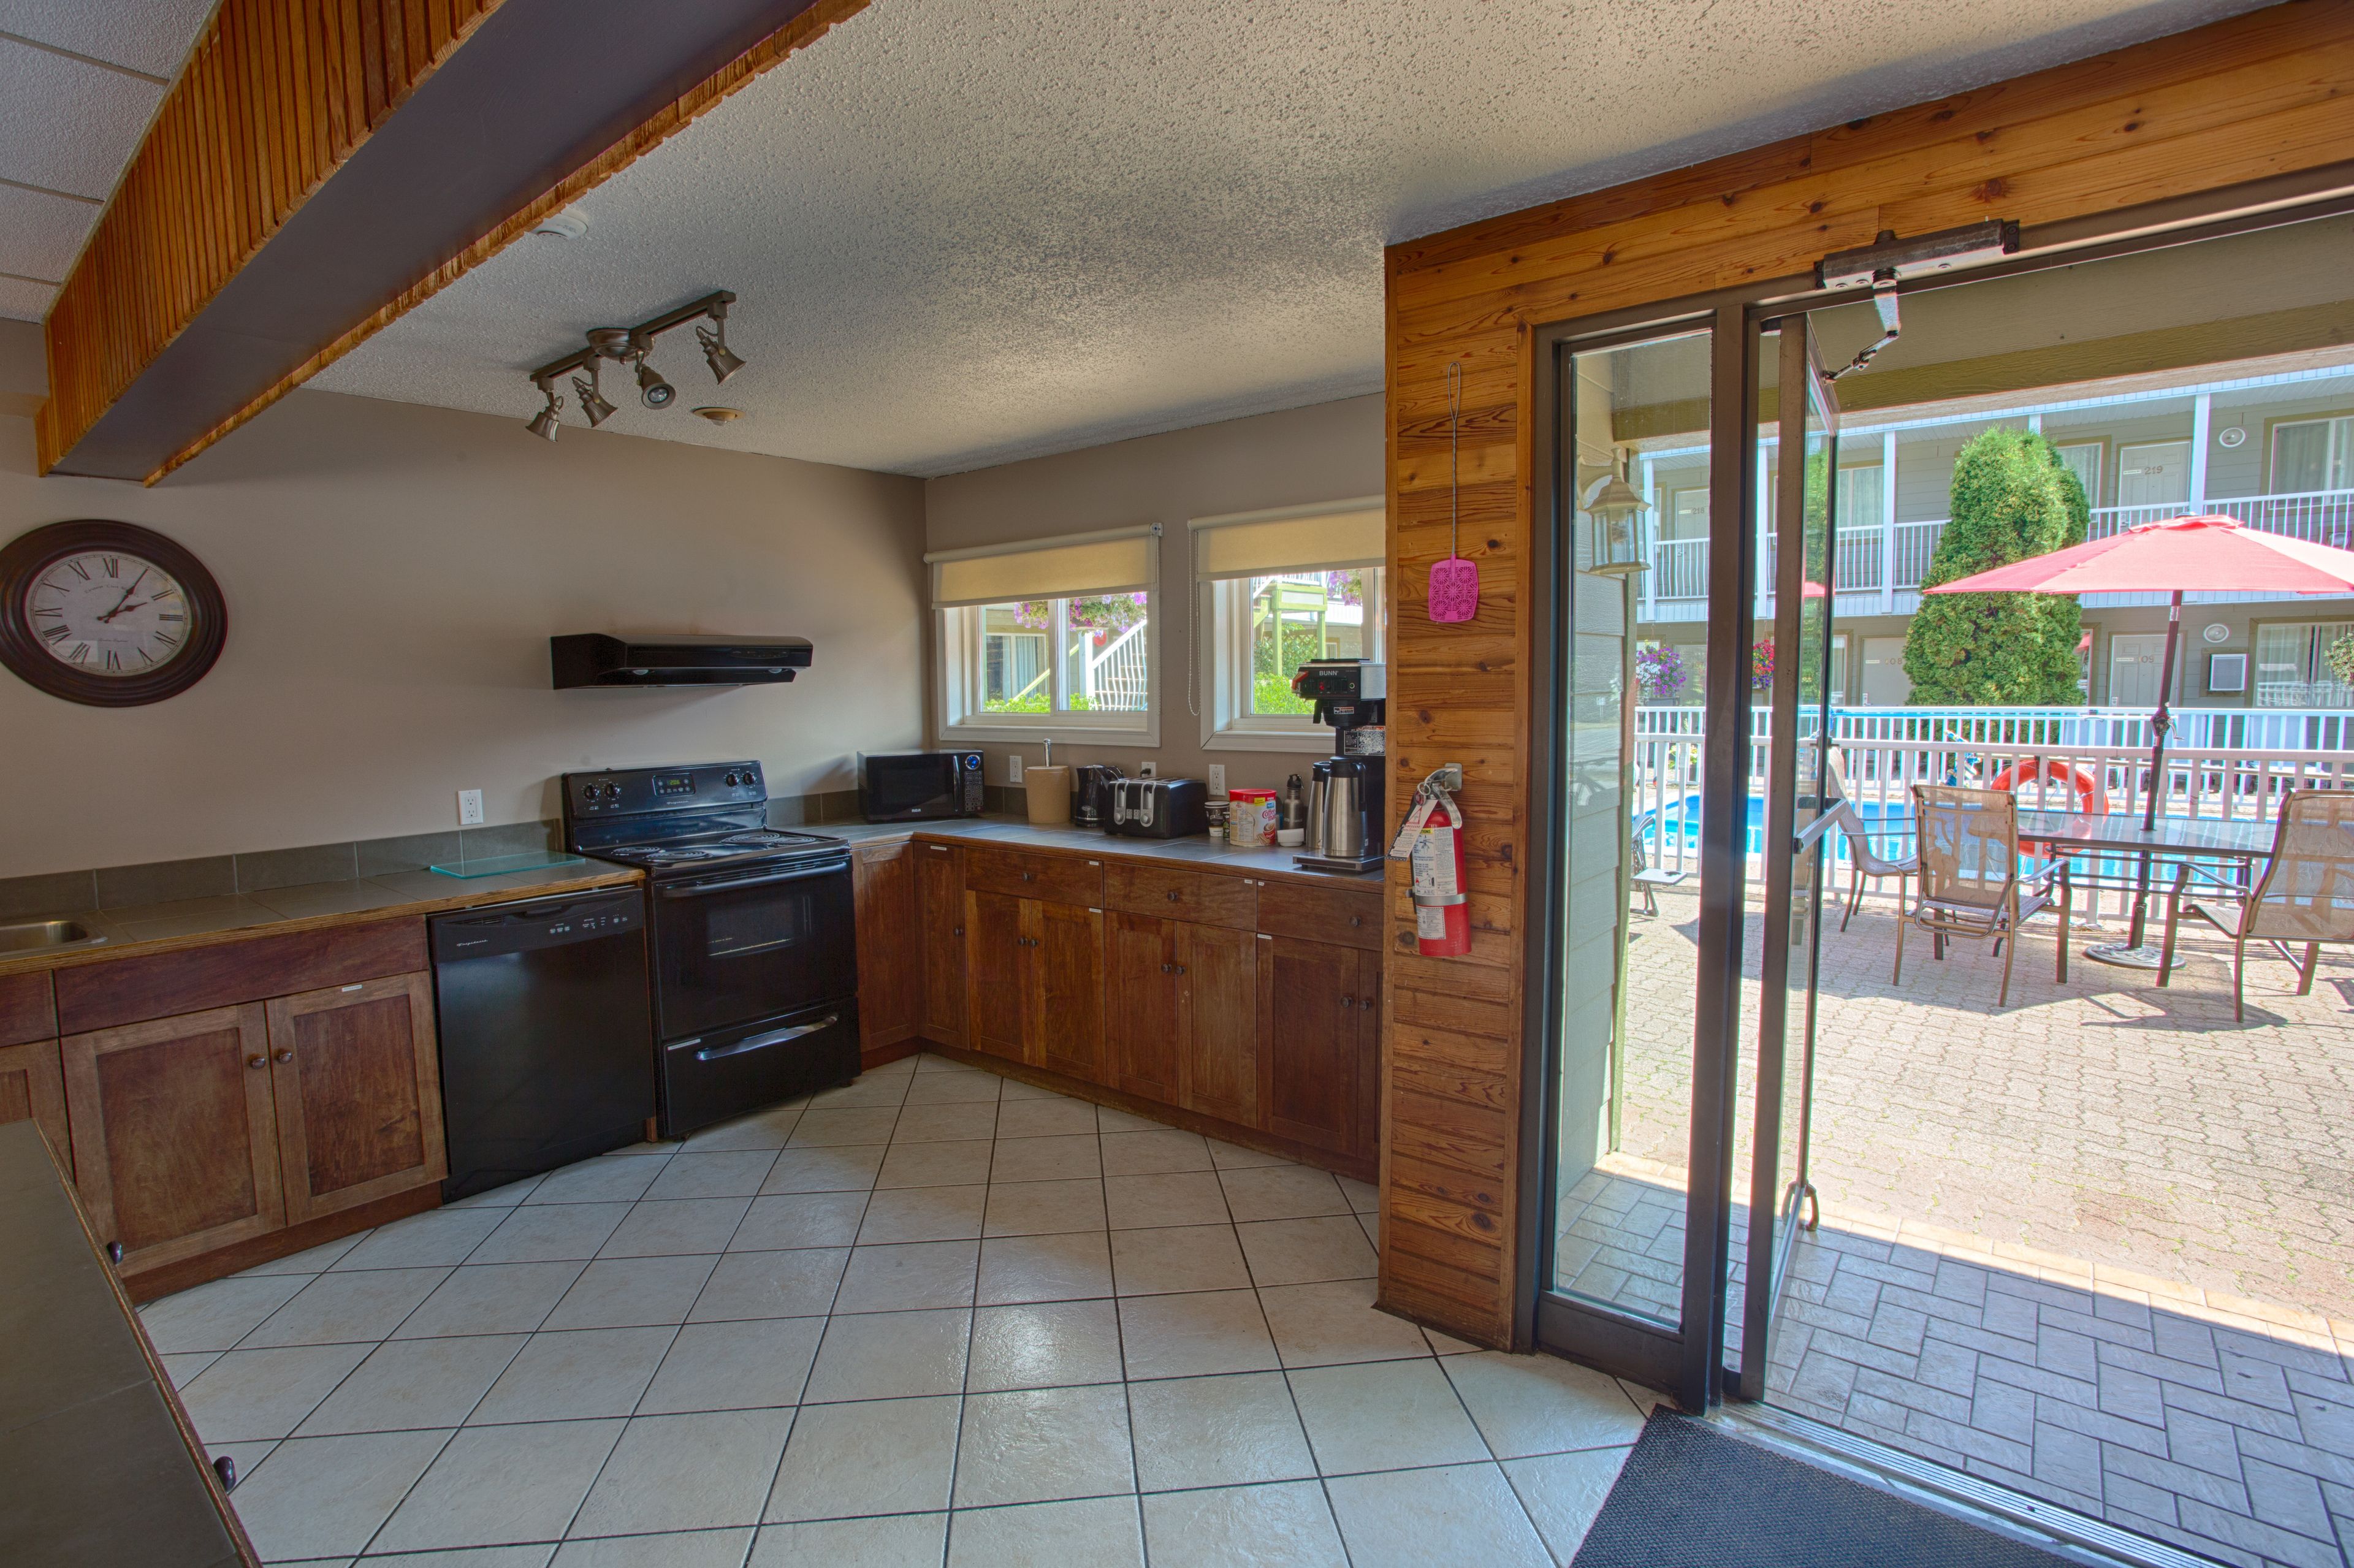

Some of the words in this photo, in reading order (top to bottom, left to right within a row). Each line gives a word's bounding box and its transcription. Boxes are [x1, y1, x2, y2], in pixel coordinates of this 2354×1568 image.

[2144, 465, 2163, 475] 219
[68, 561, 91, 584] XI
[102, 558, 119, 578] XII
[42, 578, 70, 598] X
[151, 588, 176, 601] II
[42, 625, 72, 646] VIII
[68, 642, 91, 665] VII
[106, 650, 121, 670] VI
[137, 647, 154, 666] V
